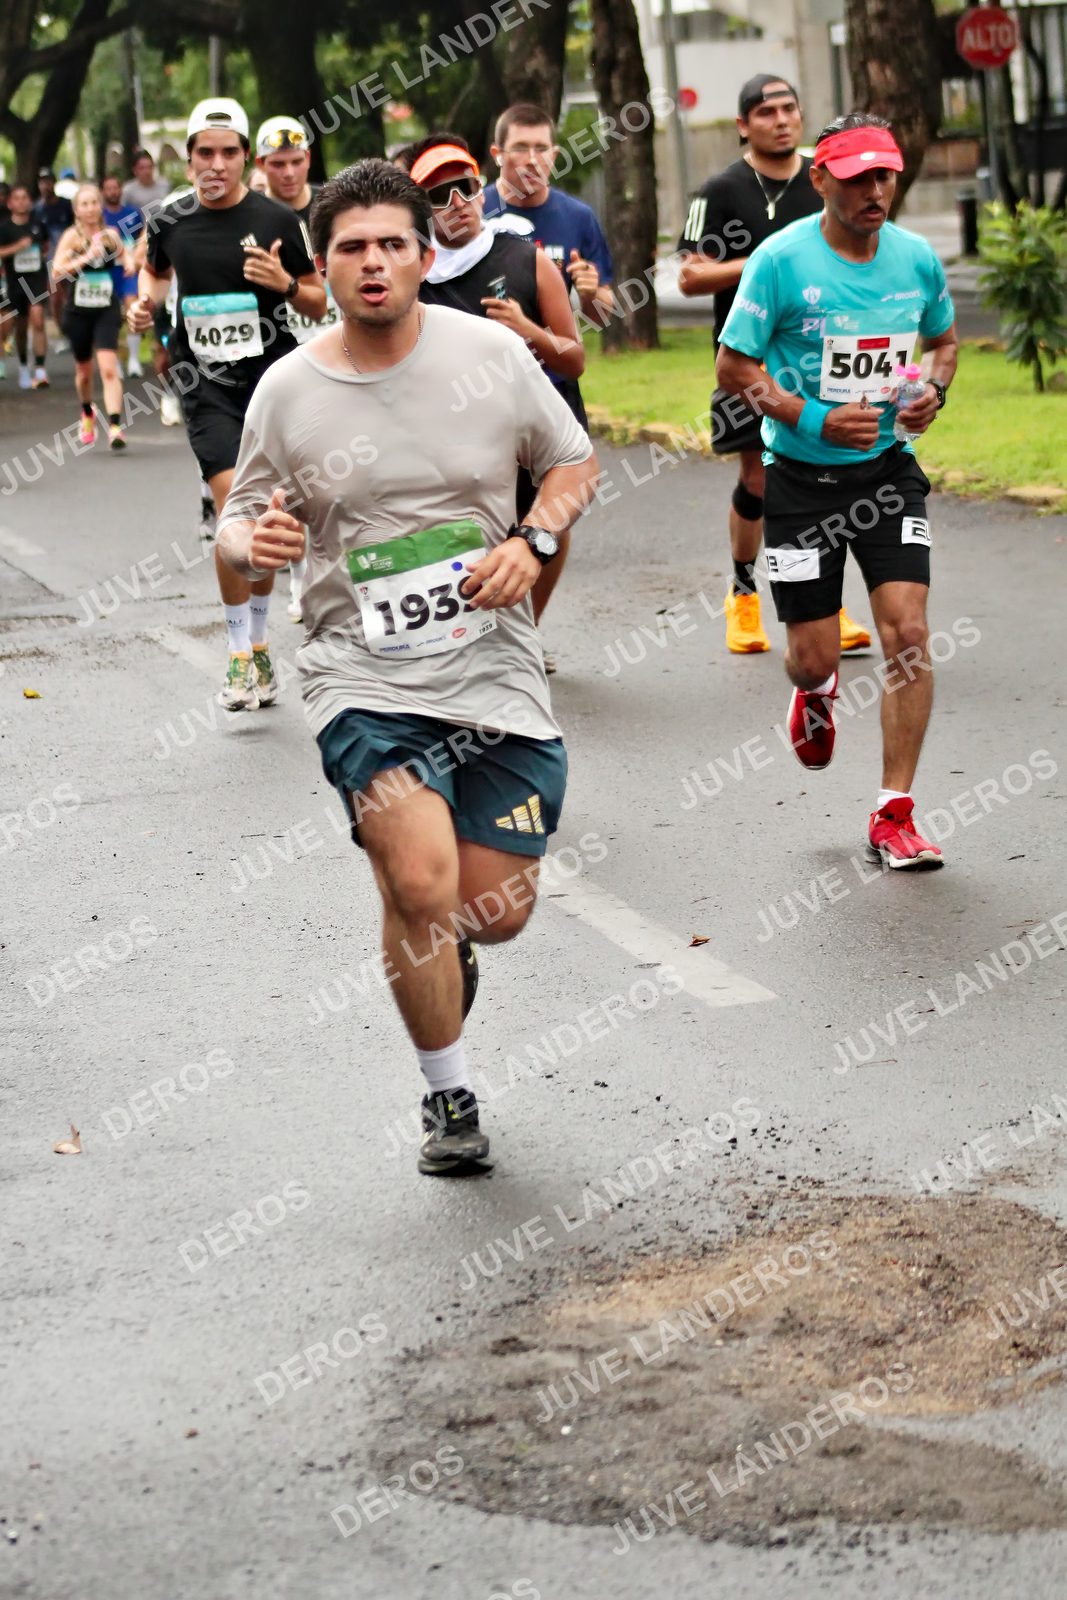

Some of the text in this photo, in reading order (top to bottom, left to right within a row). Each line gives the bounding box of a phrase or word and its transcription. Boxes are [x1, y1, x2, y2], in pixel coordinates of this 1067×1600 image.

[960, 23, 1013, 51] ALTO
[286, 307, 338, 330] 305
[194, 323, 255, 347] 4029
[828, 350, 908, 380] 5041
[373, 575, 484, 636] 1939
